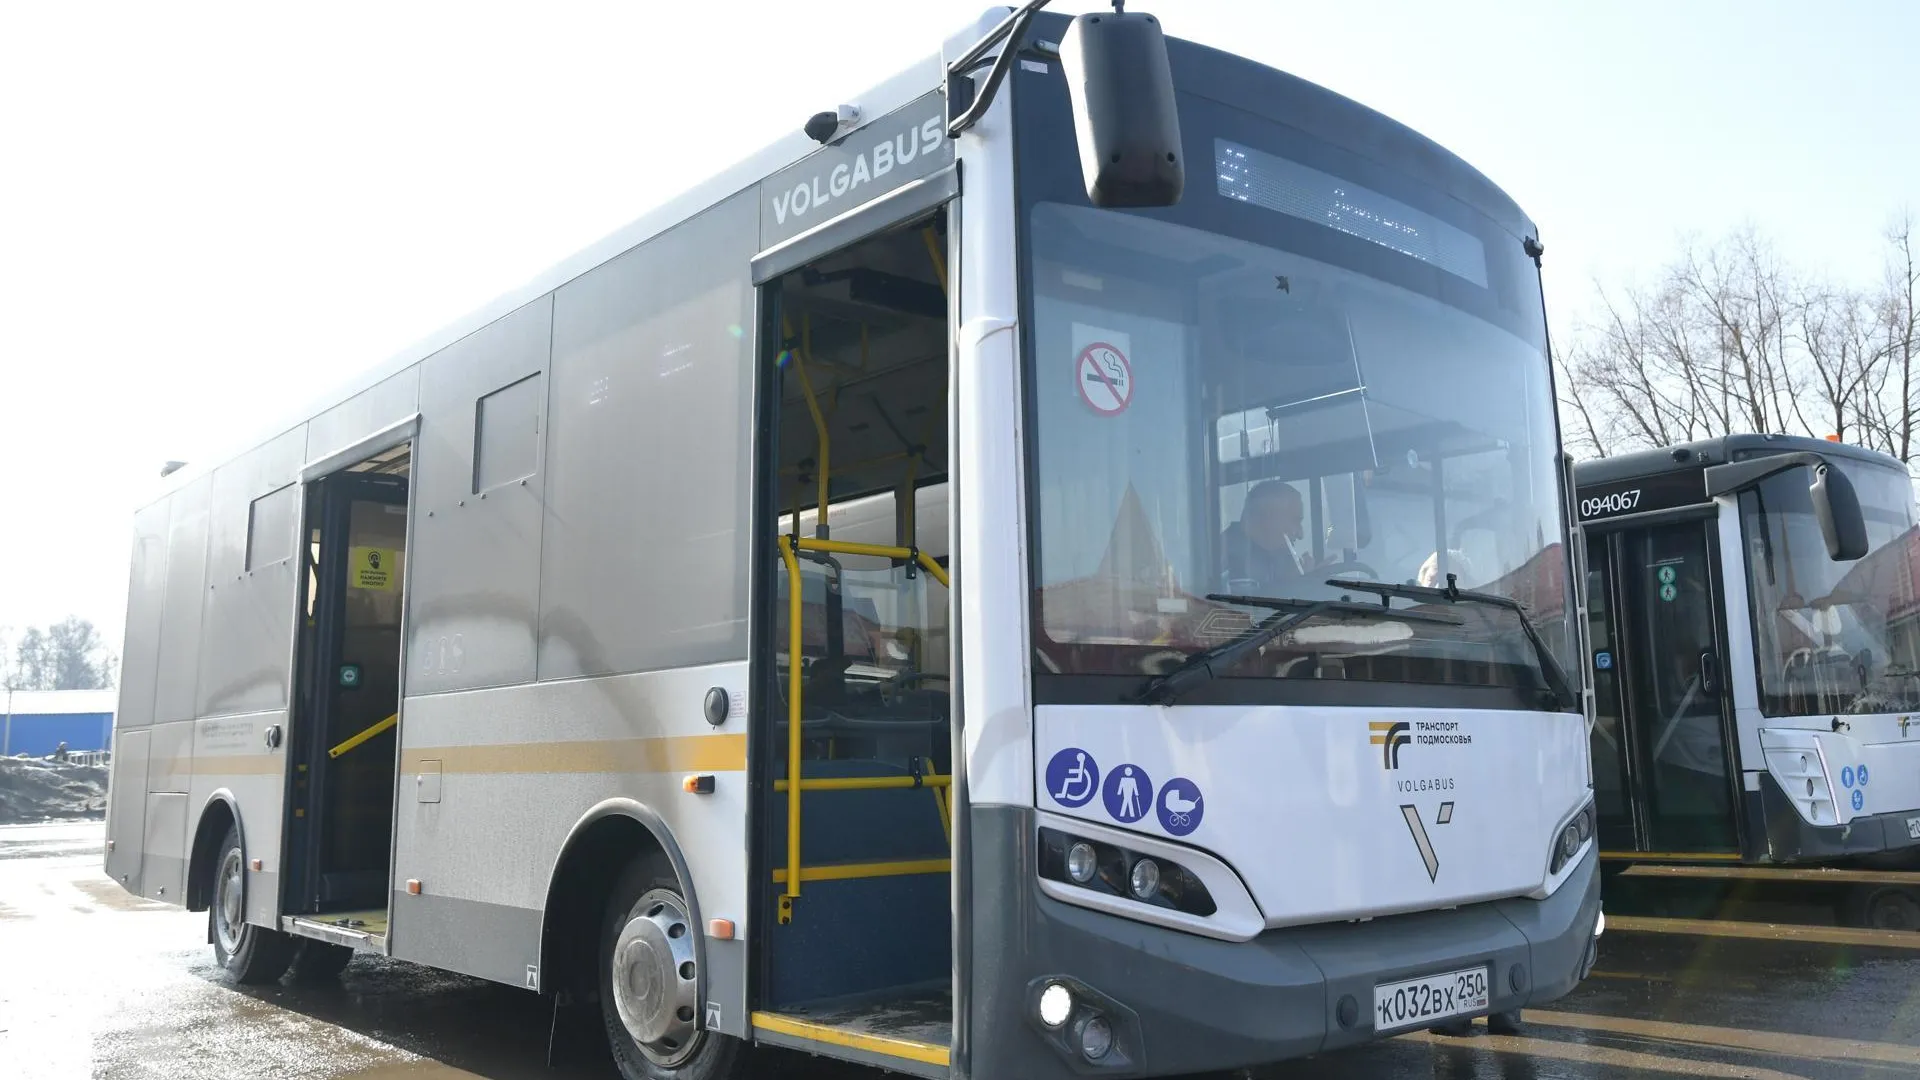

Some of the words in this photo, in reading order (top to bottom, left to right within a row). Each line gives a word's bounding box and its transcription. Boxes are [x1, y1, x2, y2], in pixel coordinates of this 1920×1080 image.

[771, 114, 943, 225] VOLGABUS
[1581, 489, 1641, 517] 094067
[1416, 722, 1459, 731] ТРАНСПОРТ
[1417, 735, 1472, 745] ПОДМОСКОВЬЯ
[1397, 778, 1455, 792] VOLGABUS
[1457, 973, 1483, 1000] 250
[1463, 999, 1477, 1009] RUS
